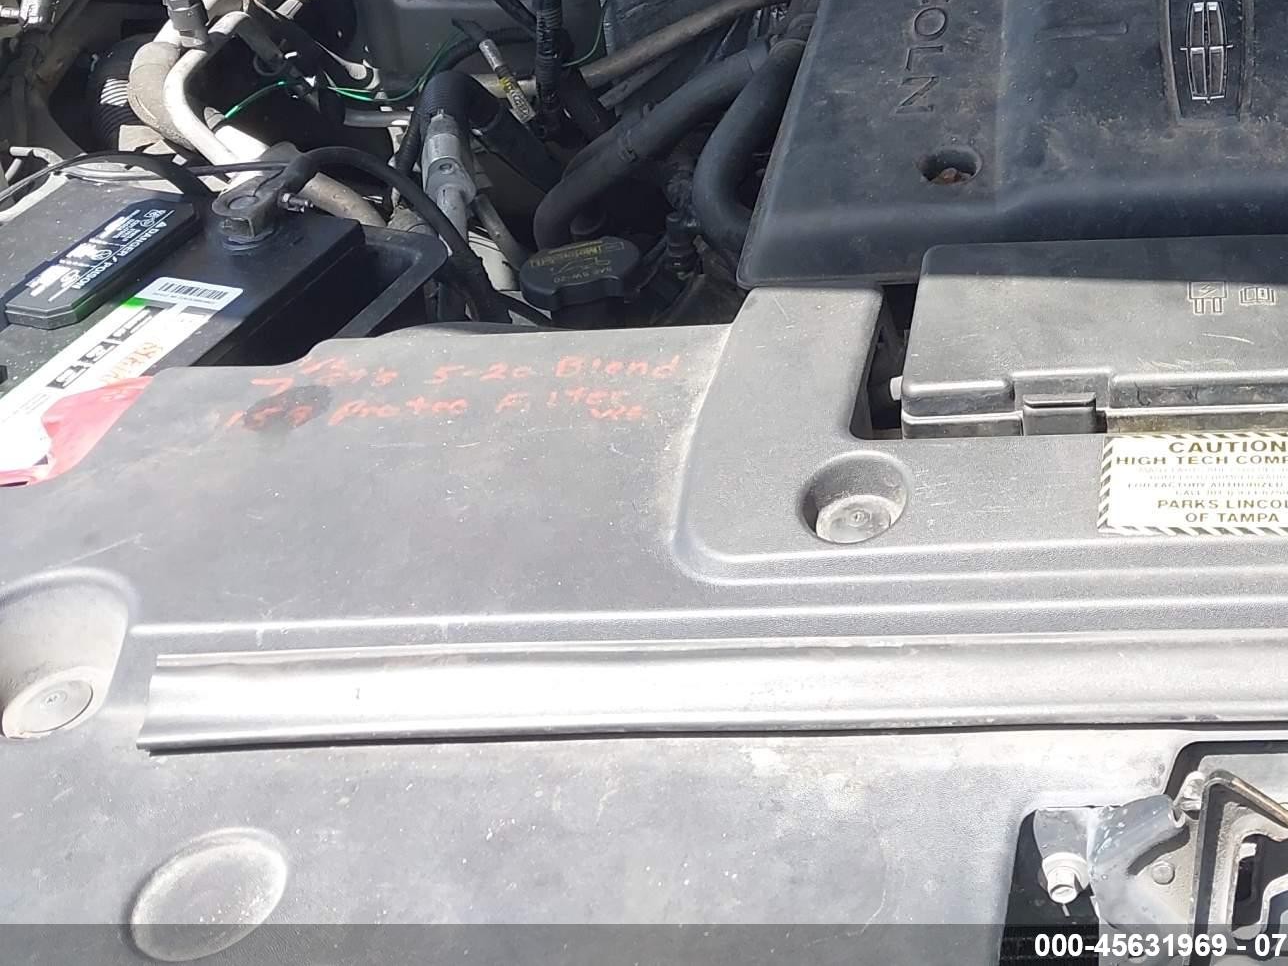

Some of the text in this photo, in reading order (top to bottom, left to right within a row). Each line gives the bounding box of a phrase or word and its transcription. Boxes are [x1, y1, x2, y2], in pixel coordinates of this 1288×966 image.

[116, 227, 160, 256] DANGER
[71, 261, 113, 290] POISON
[1116, 456, 1167, 465] HIGH
[1176, 456, 1228, 465] TECH
[1157, 499, 1219, 509] PARKS
[1185, 512, 1280, 523] OF TAMPA
